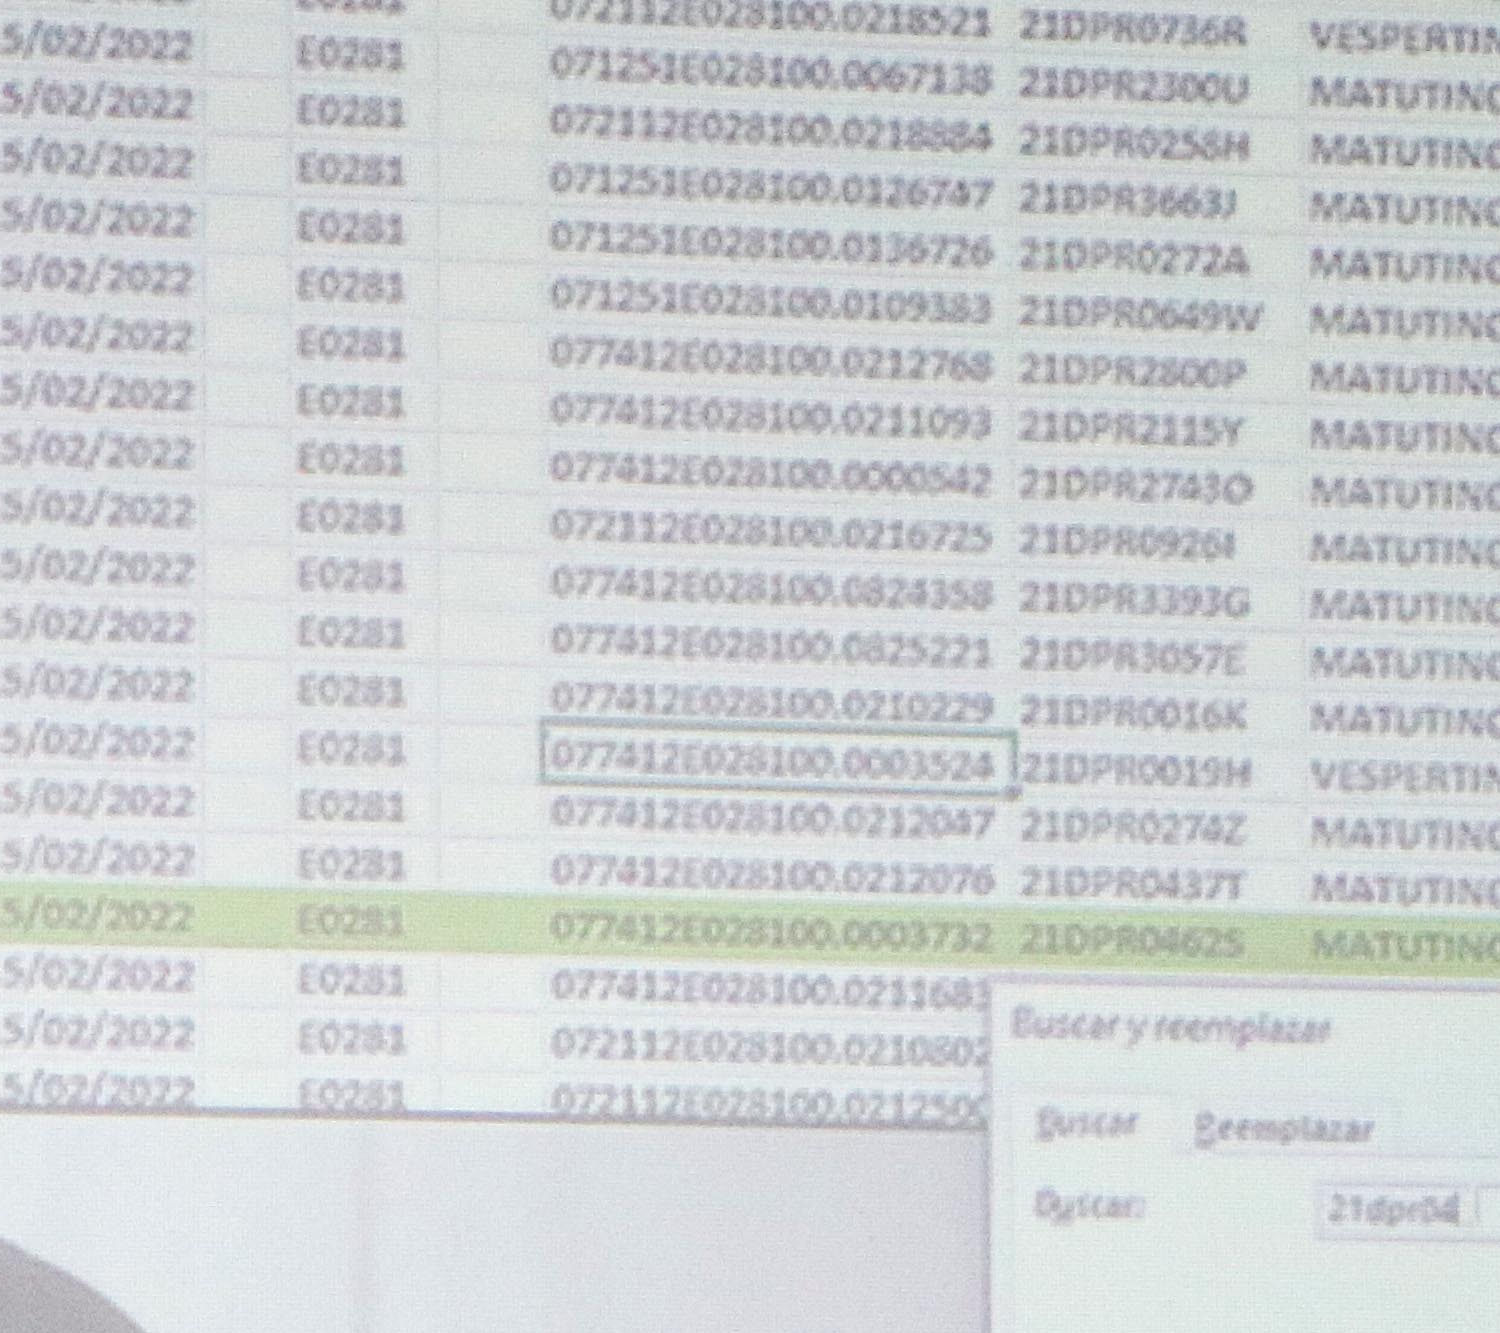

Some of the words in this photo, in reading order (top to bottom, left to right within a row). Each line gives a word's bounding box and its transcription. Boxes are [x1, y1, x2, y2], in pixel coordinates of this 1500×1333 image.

[296, 206, 406, 247] E0281
[296, 555, 406, 595] E0281
[296, 900, 407, 941] E0281
[297, 961, 406, 999] E0281
[1010, 1003, 1123, 1041] Buscar
[1153, 1010, 1333, 1050] reemplazar
[1035, 1104, 1141, 1143] Buscar
[1194, 1110, 1376, 1150] Reemplazar
